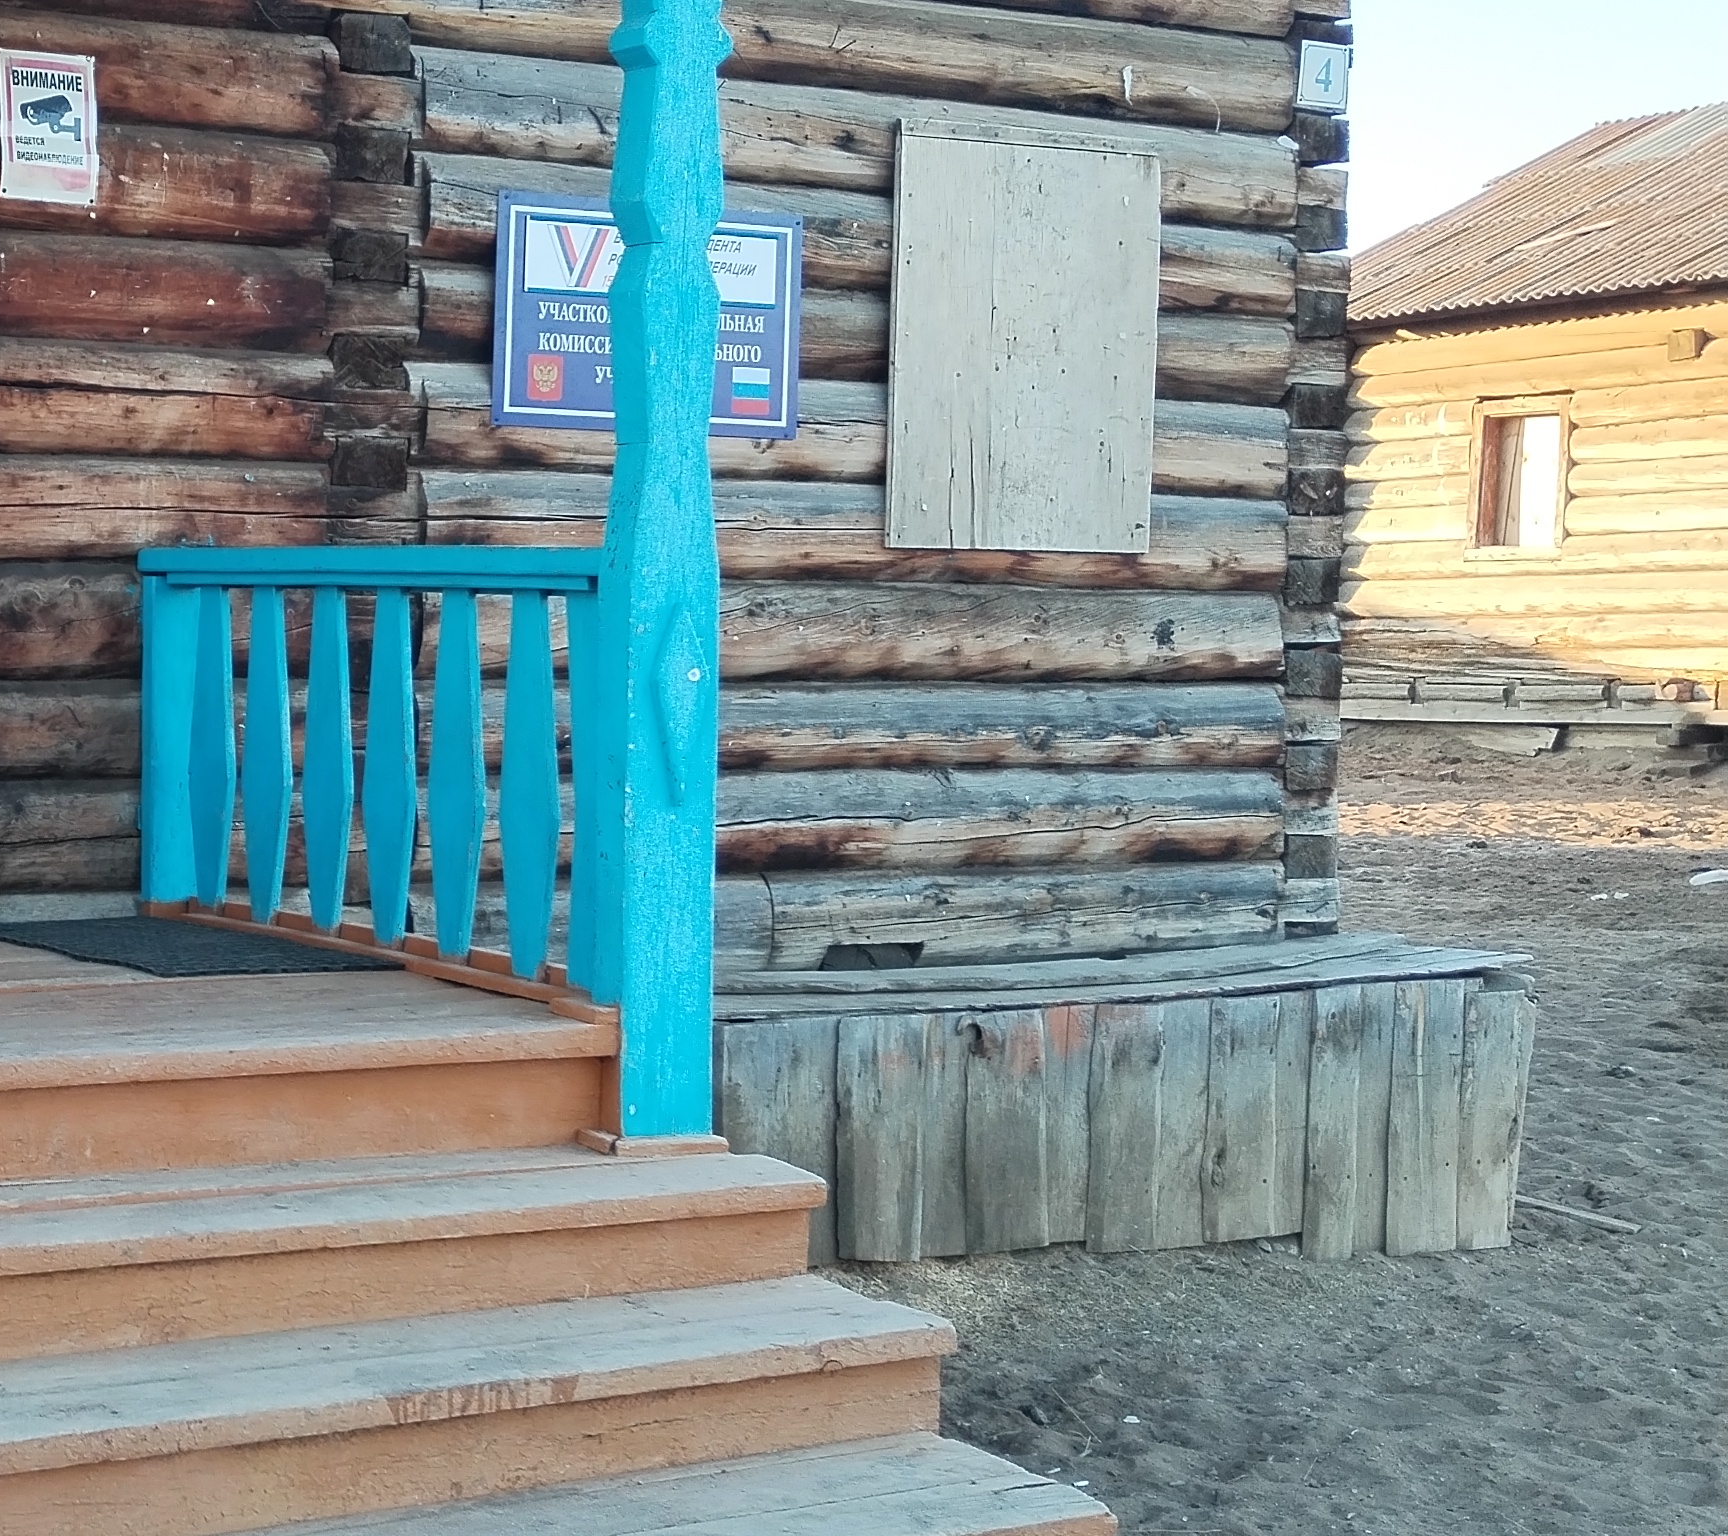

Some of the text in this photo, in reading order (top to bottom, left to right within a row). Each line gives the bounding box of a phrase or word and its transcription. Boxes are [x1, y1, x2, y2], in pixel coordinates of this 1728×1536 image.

[12, 69, 83, 93] ВНИМАНИЕ
[1314, 57, 1333, 93] 4
[15, 134, 45, 146] ВЕДЕТСЯ
[16, 150, 84, 166] ВИДЕОНАБЛЮДЕНИЕ
[707, 239, 742, 253] ДЕНТА
[712, 261, 757, 278] ЕРАЦИИ
[538, 301, 611, 324] УЧАСТКО
[538, 332, 612, 355] КОМИССИ
